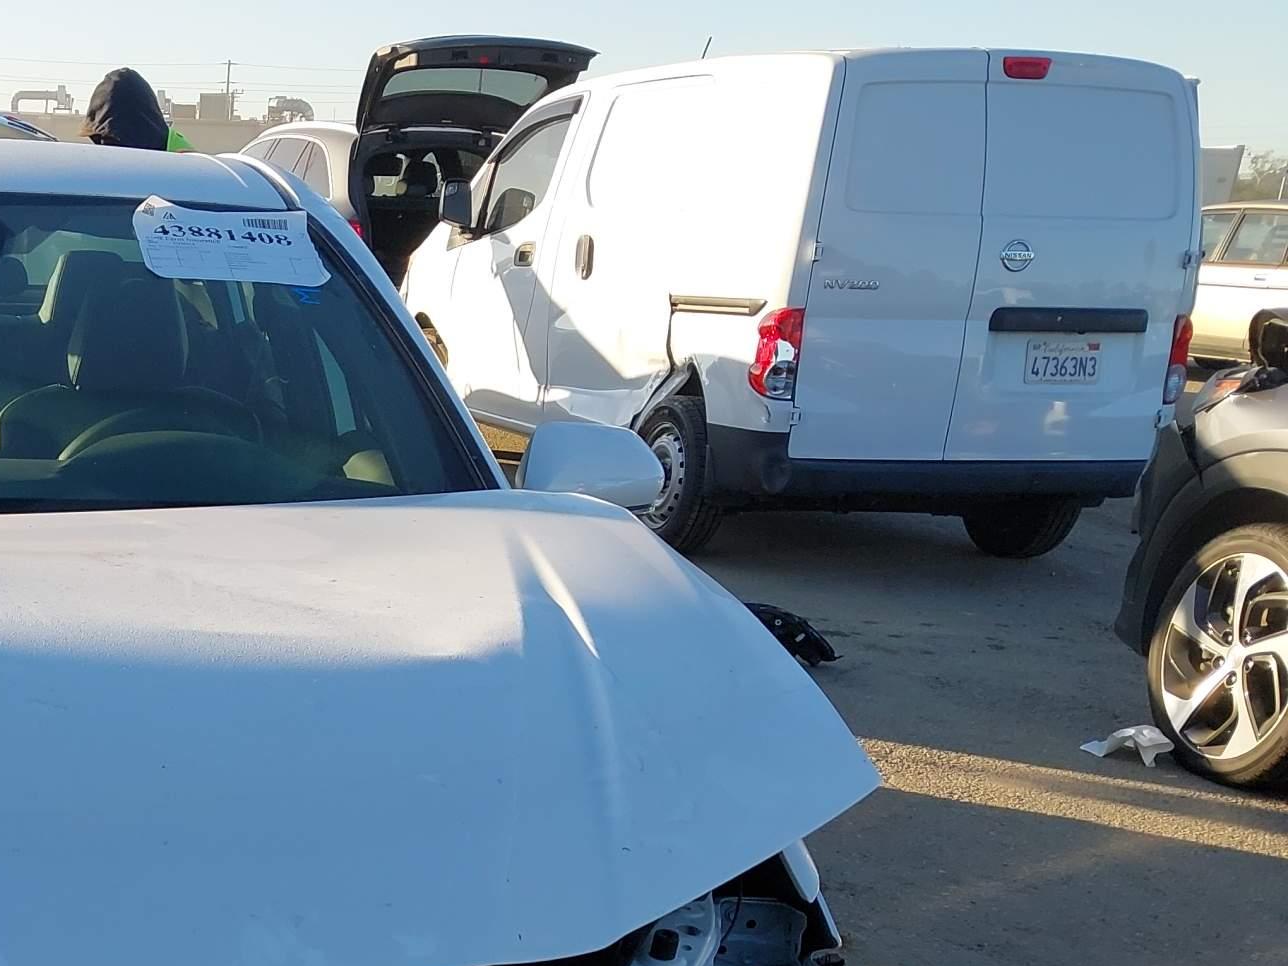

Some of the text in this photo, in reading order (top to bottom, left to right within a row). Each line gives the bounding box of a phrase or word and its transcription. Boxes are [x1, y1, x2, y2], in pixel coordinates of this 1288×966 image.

[154, 224, 292, 246] 43881408
[1004, 251, 1033, 259] NISSAN
[823, 279, 880, 291] NV200
[1030, 356, 1097, 377] 47363N3
